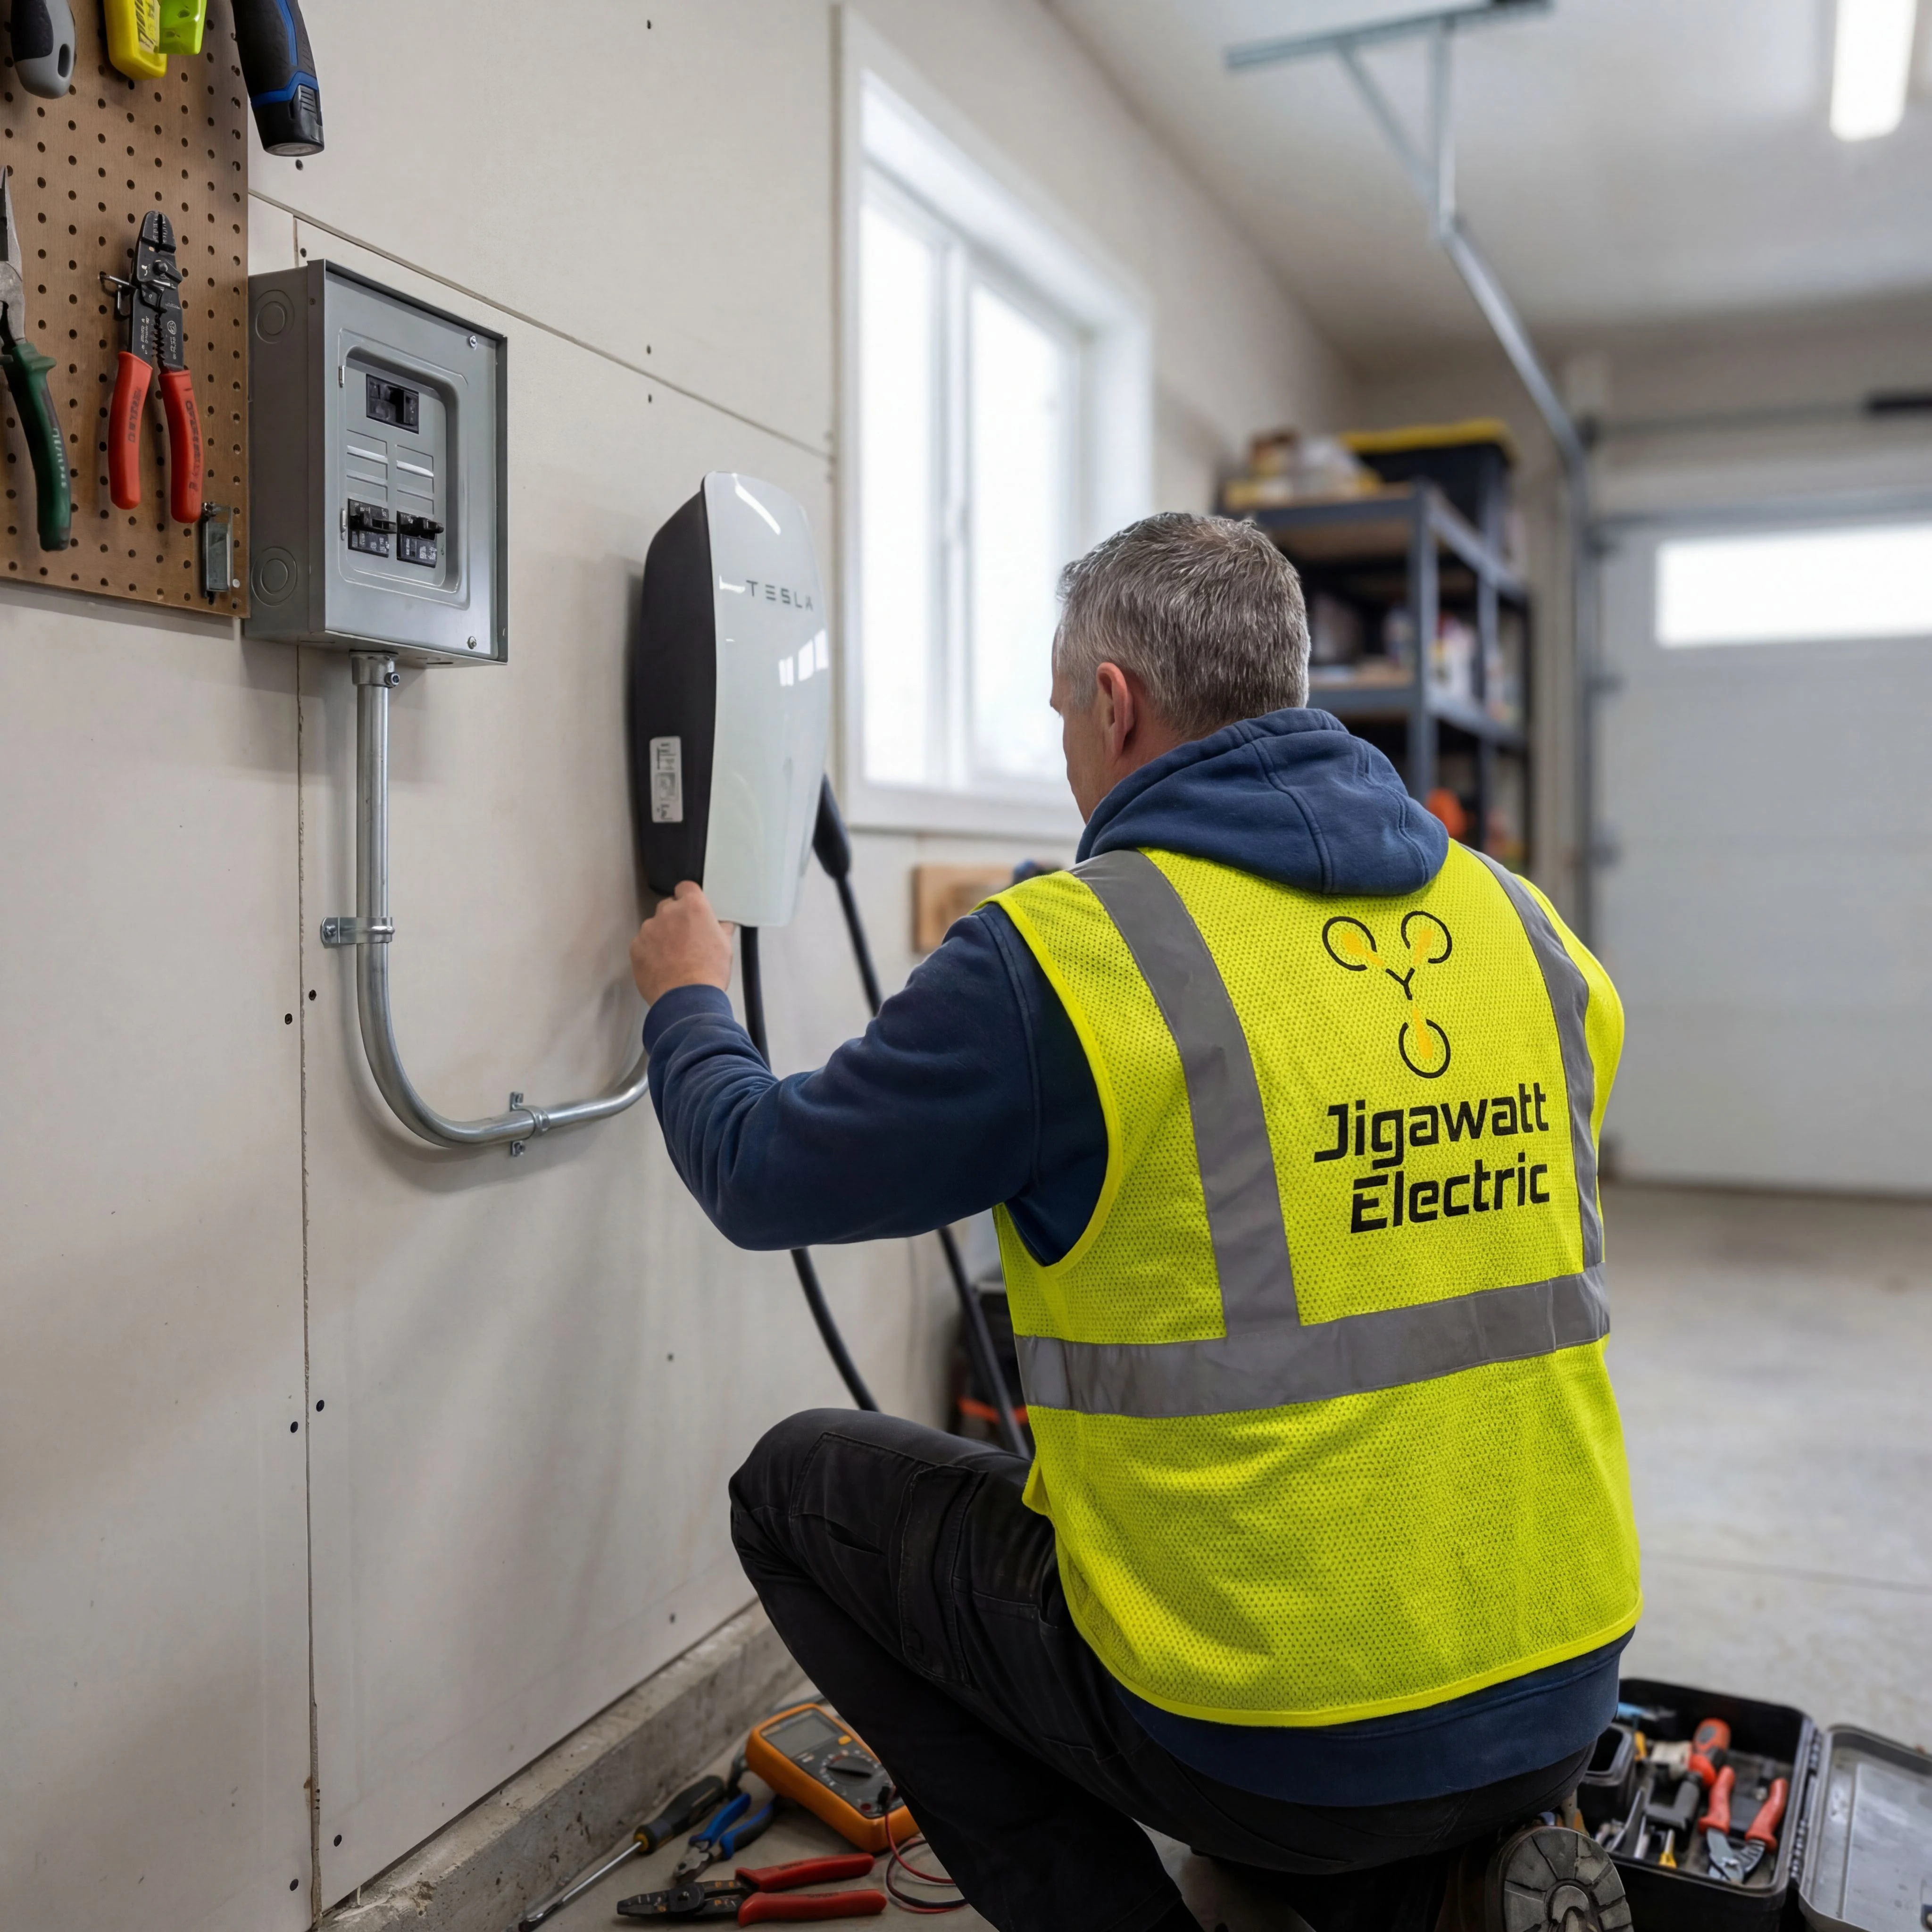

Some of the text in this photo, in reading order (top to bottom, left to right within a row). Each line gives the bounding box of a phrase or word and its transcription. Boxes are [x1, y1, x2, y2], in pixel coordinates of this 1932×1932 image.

[746, 580, 813, 611] TESLA
[1314, 1083, 1549, 1170] Jigawatt
[1350, 1152, 1549, 1233] Electric
